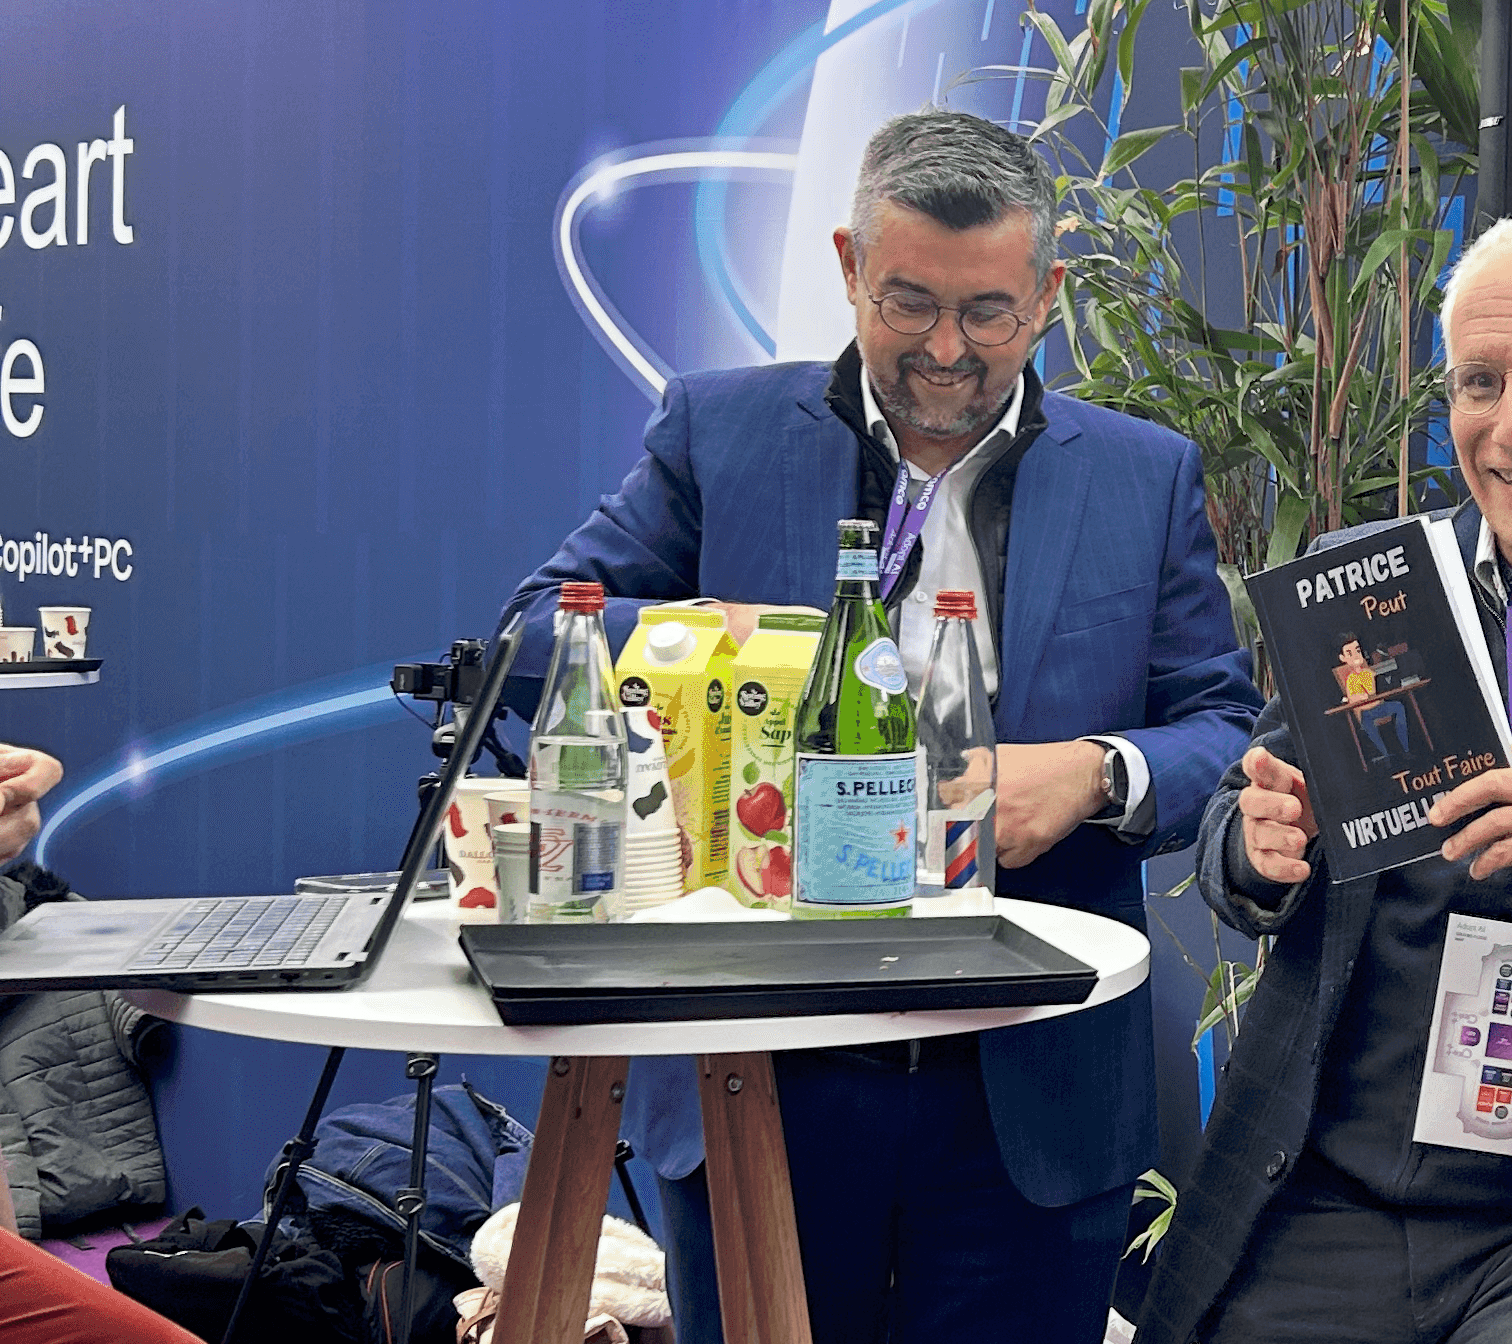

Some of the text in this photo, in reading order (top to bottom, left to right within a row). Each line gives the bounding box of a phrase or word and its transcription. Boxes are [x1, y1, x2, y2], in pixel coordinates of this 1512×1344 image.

[0, 336, 45, 438] e
[0, 531, 133, 582] opilot+PC
[1295, 545, 1410, 609] PATRICE
[1360, 589, 1408, 621] Peut
[761, 727, 792, 744] Sap
[1391, 749, 1497, 795] Tout Faire
[1341, 790, 1452, 850] VIRTUELL
